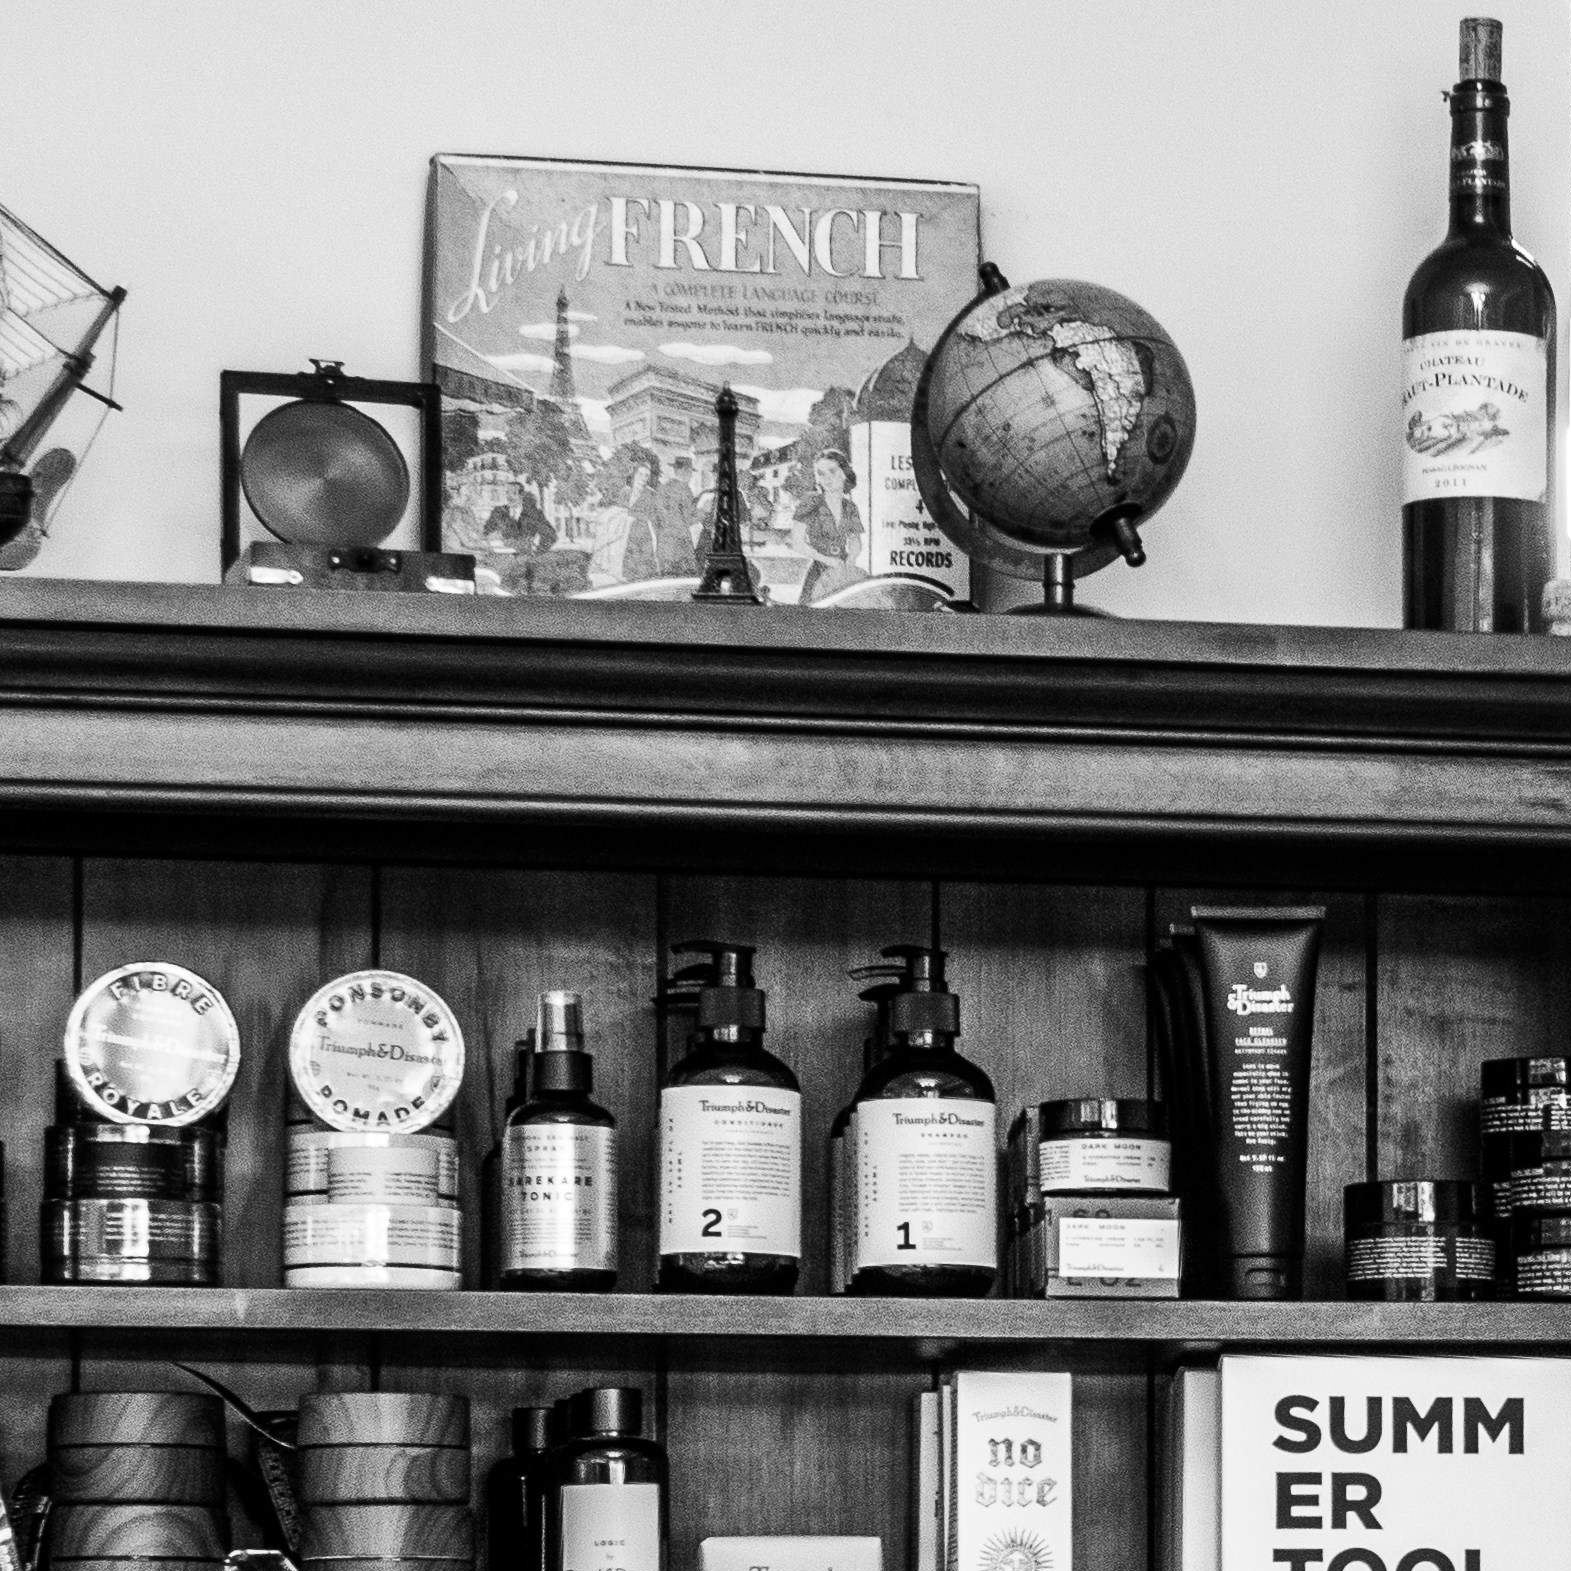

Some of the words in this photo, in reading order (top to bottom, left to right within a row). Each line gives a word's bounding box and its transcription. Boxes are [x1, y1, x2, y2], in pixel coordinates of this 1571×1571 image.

[447, 188, 601, 323] Living
[605, 196, 924, 282] FRENCH
[663, 282, 737, 299] COMPLETE
[742, 284, 817, 302] LANGUAGE
[824, 289, 878, 305] COURSE
[755, 321, 798, 334] FRENCH
[1402, 371, 1529, 409] AUT-PLANTADE
[891, 455, 913, 471] LES
[1434, 478, 1467, 488] 2011
[890, 550, 954, 569] RECORDS
[109, 974, 213, 1016] FIBRE
[1232, 984, 1292, 1004] Triumph
[315, 982, 449, 1042] PONSONBY
[88, 1072, 201, 1121] ROYALE
[319, 1084, 426, 1127] POMADE
[1114, 1143, 1142, 1151] MOON
[702, 1208, 722, 1238] 2
[897, 1221, 917, 1250] 1
[1272, 1394, 1525, 1455] SUMM
[988, 1437, 1043, 1469] no
[975, 1471, 1058, 1508] dice
[1275, 1471, 1383, 1530] ER
